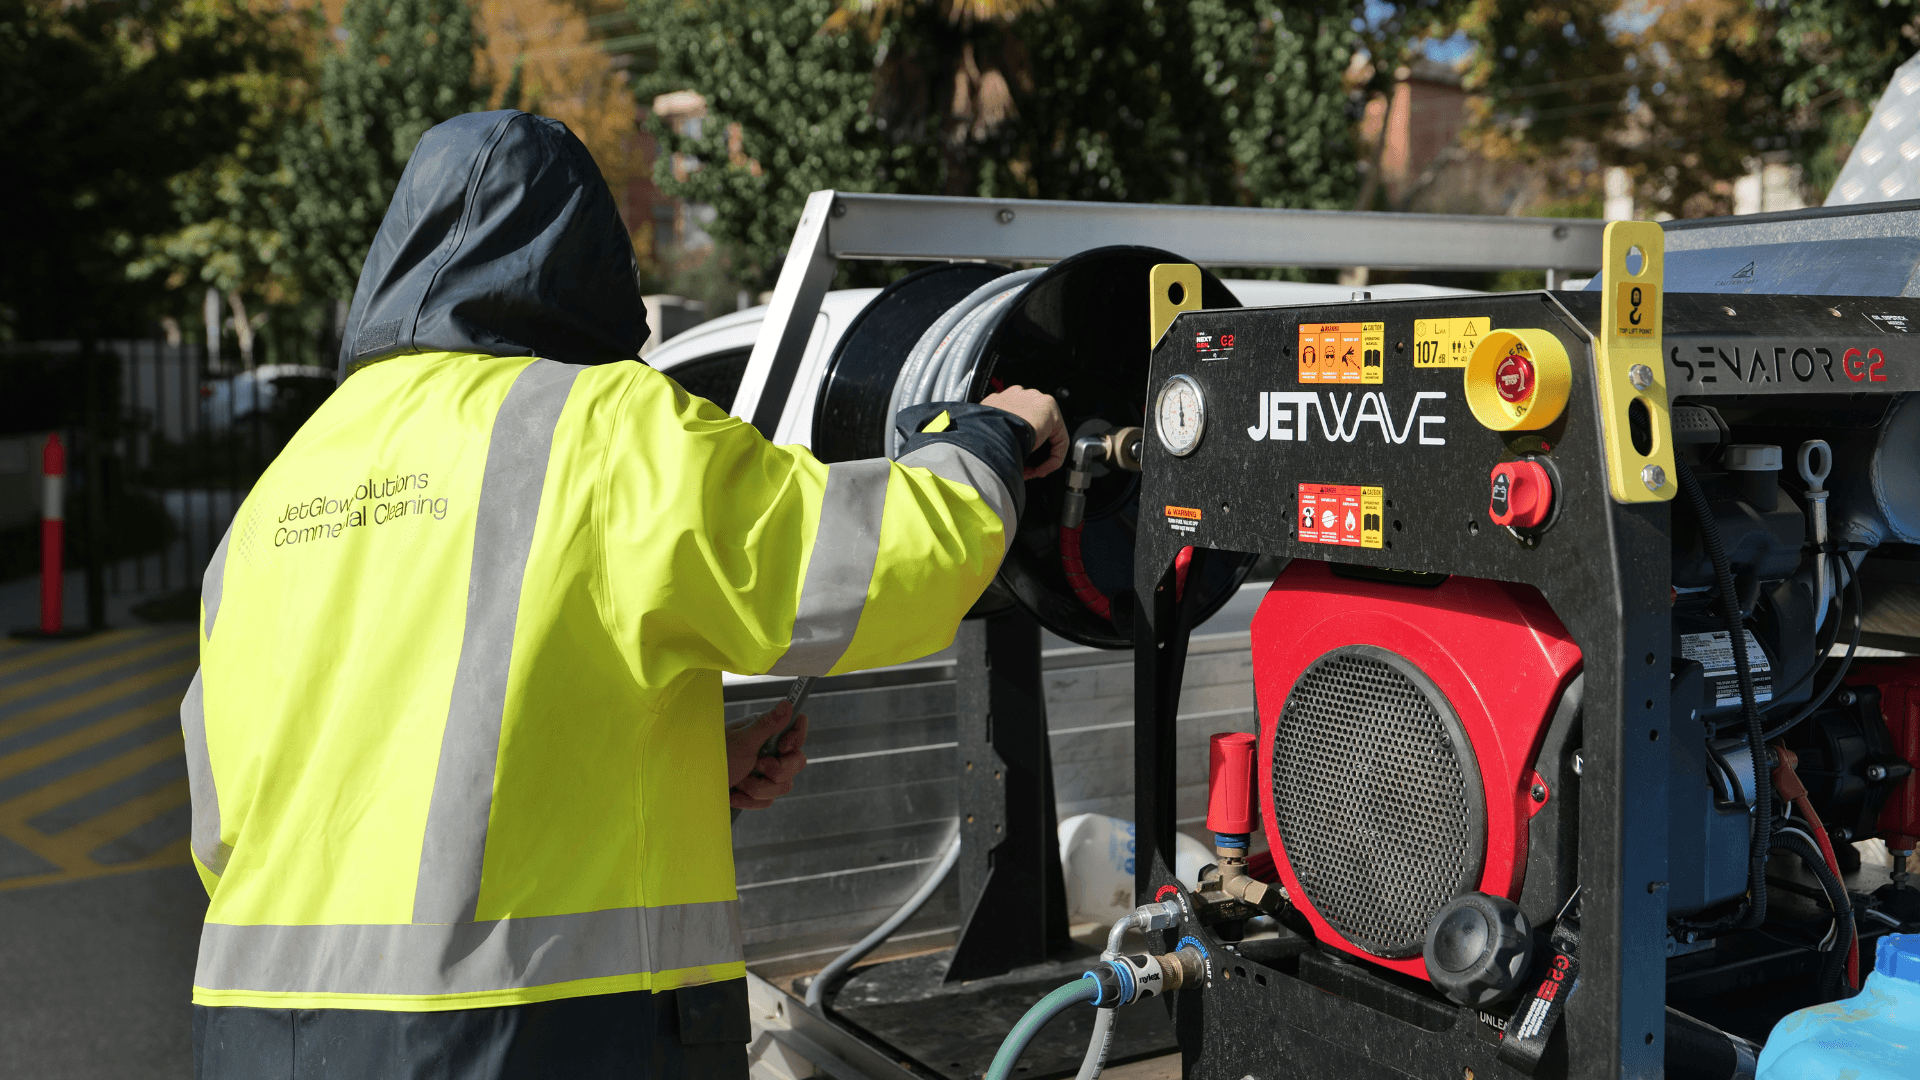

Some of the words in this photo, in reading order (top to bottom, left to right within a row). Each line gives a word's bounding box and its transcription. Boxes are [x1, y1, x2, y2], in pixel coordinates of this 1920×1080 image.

[1196, 335, 1213, 343] NEXT
[1220, 334, 1234, 347] G2
[1416, 340, 1439, 364] 107
[1438, 353, 1446, 364] dB
[1671, 346, 1834, 383] SENATOR
[1842, 347, 1888, 382] G2
[1247, 391, 1447, 446] JETWAVE
[278, 496, 355, 523] JetGlow
[355, 473, 429, 501] olutions
[275, 506, 367, 547] Commeial
[374, 494, 448, 525] Cleaning
[1177, 892, 1188, 914] OUTLET
[1182, 935, 1209, 959] PRESSURE
[1139, 972, 1160, 983] nylex
[1546, 954, 1570, 981] G2
[1480, 1010, 1508, 1031] UNLEA
